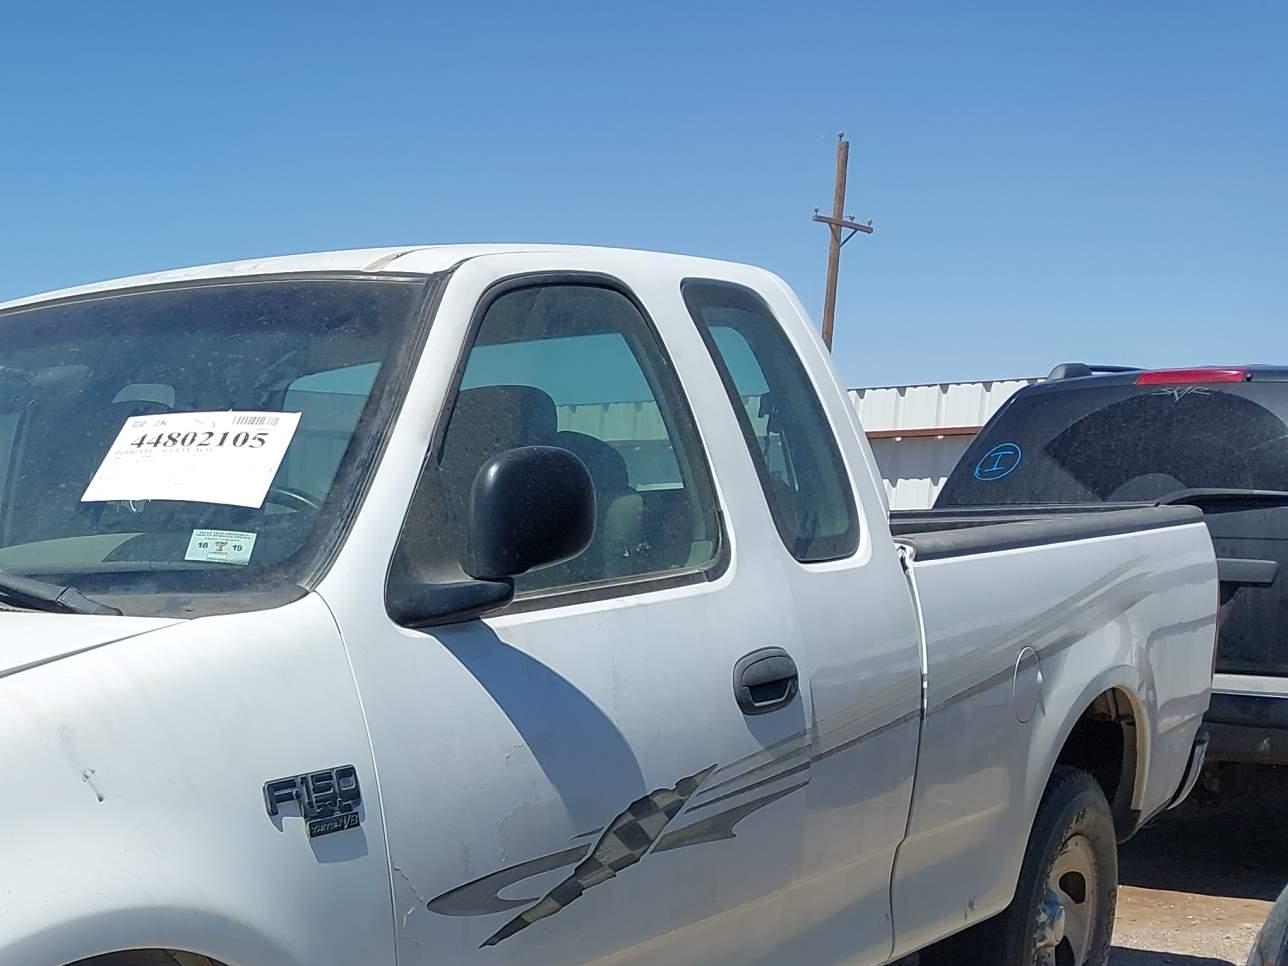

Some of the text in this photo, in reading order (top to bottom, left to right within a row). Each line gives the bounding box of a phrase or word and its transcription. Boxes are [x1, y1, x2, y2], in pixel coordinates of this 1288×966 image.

[130, 431, 270, 449] 44802105
[232, 544, 243, 552] 19
[343, 814, 359, 829] V8
